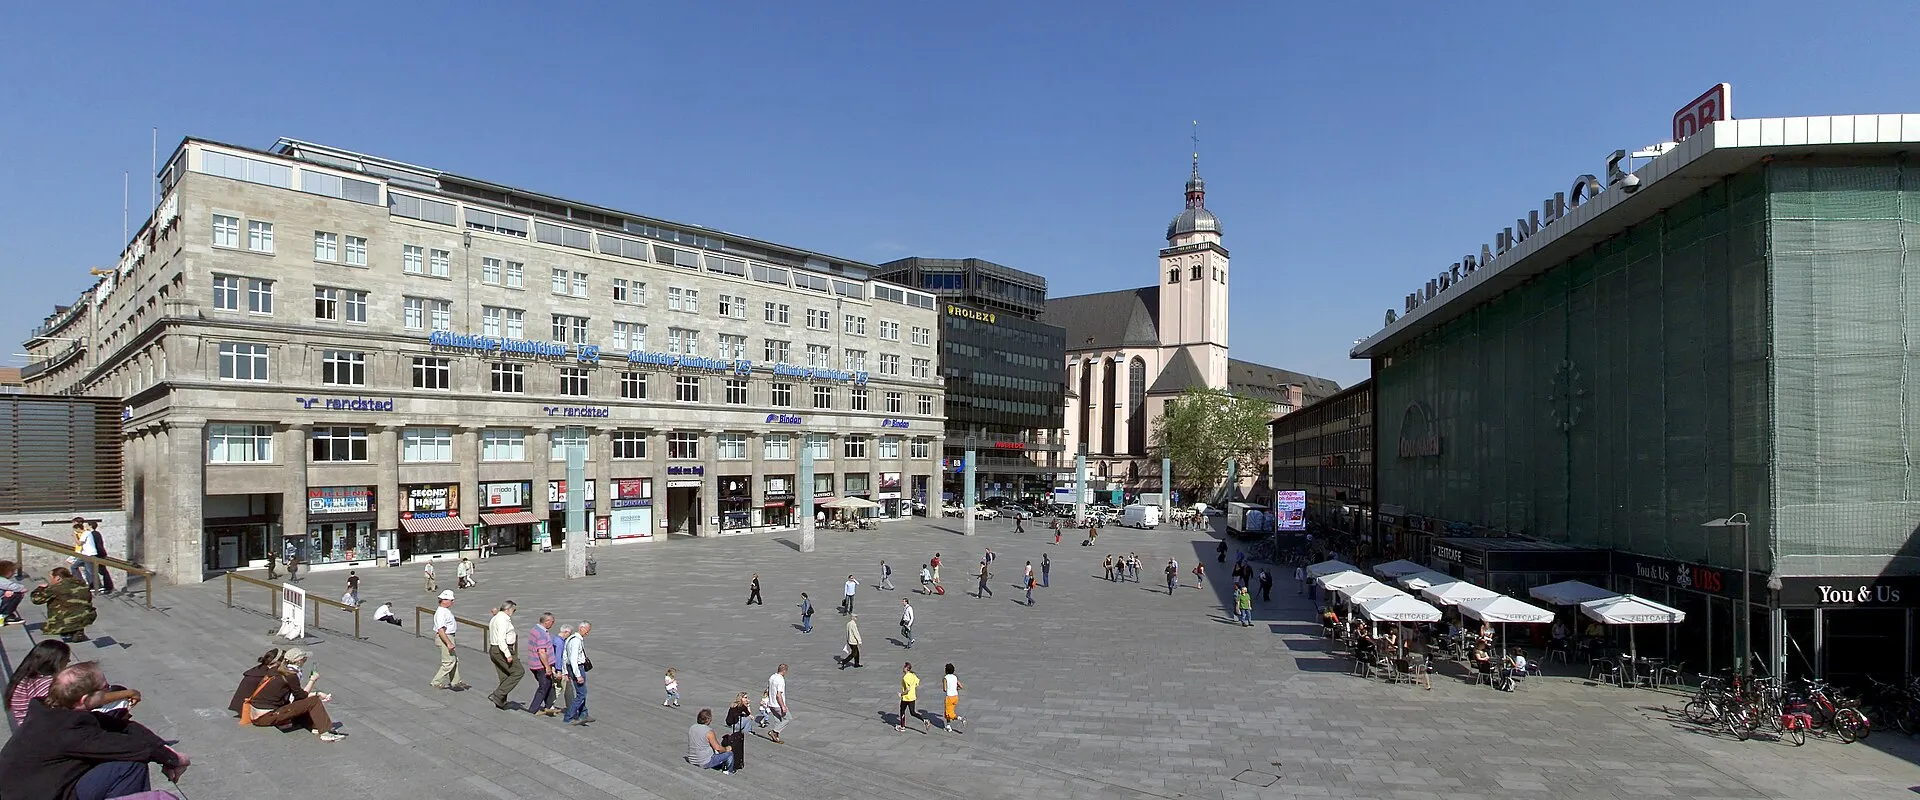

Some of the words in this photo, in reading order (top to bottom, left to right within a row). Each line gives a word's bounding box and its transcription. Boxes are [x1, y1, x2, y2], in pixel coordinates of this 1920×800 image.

[1678, 98, 1716, 140] DB
[1405, 149, 1626, 313] HAUPTBAHNHOF
[954, 307, 990, 321] ROLEX
[326, 396, 393, 411] randstad
[563, 405, 608, 417] randstad
[410, 488, 446, 497] SECOND
[415, 498, 443, 506] HAND
[1636, 562, 1650, 578] You
[1650, 567, 1657, 579] &
[1658, 566, 1669, 581] Us
[1693, 567, 1722, 592] UBS
[1818, 585, 1854, 602] You
[1857, 585, 1872, 602] &
[1876, 585, 1900, 602] Us
[1394, 612, 1430, 620] ZEITCAFE
